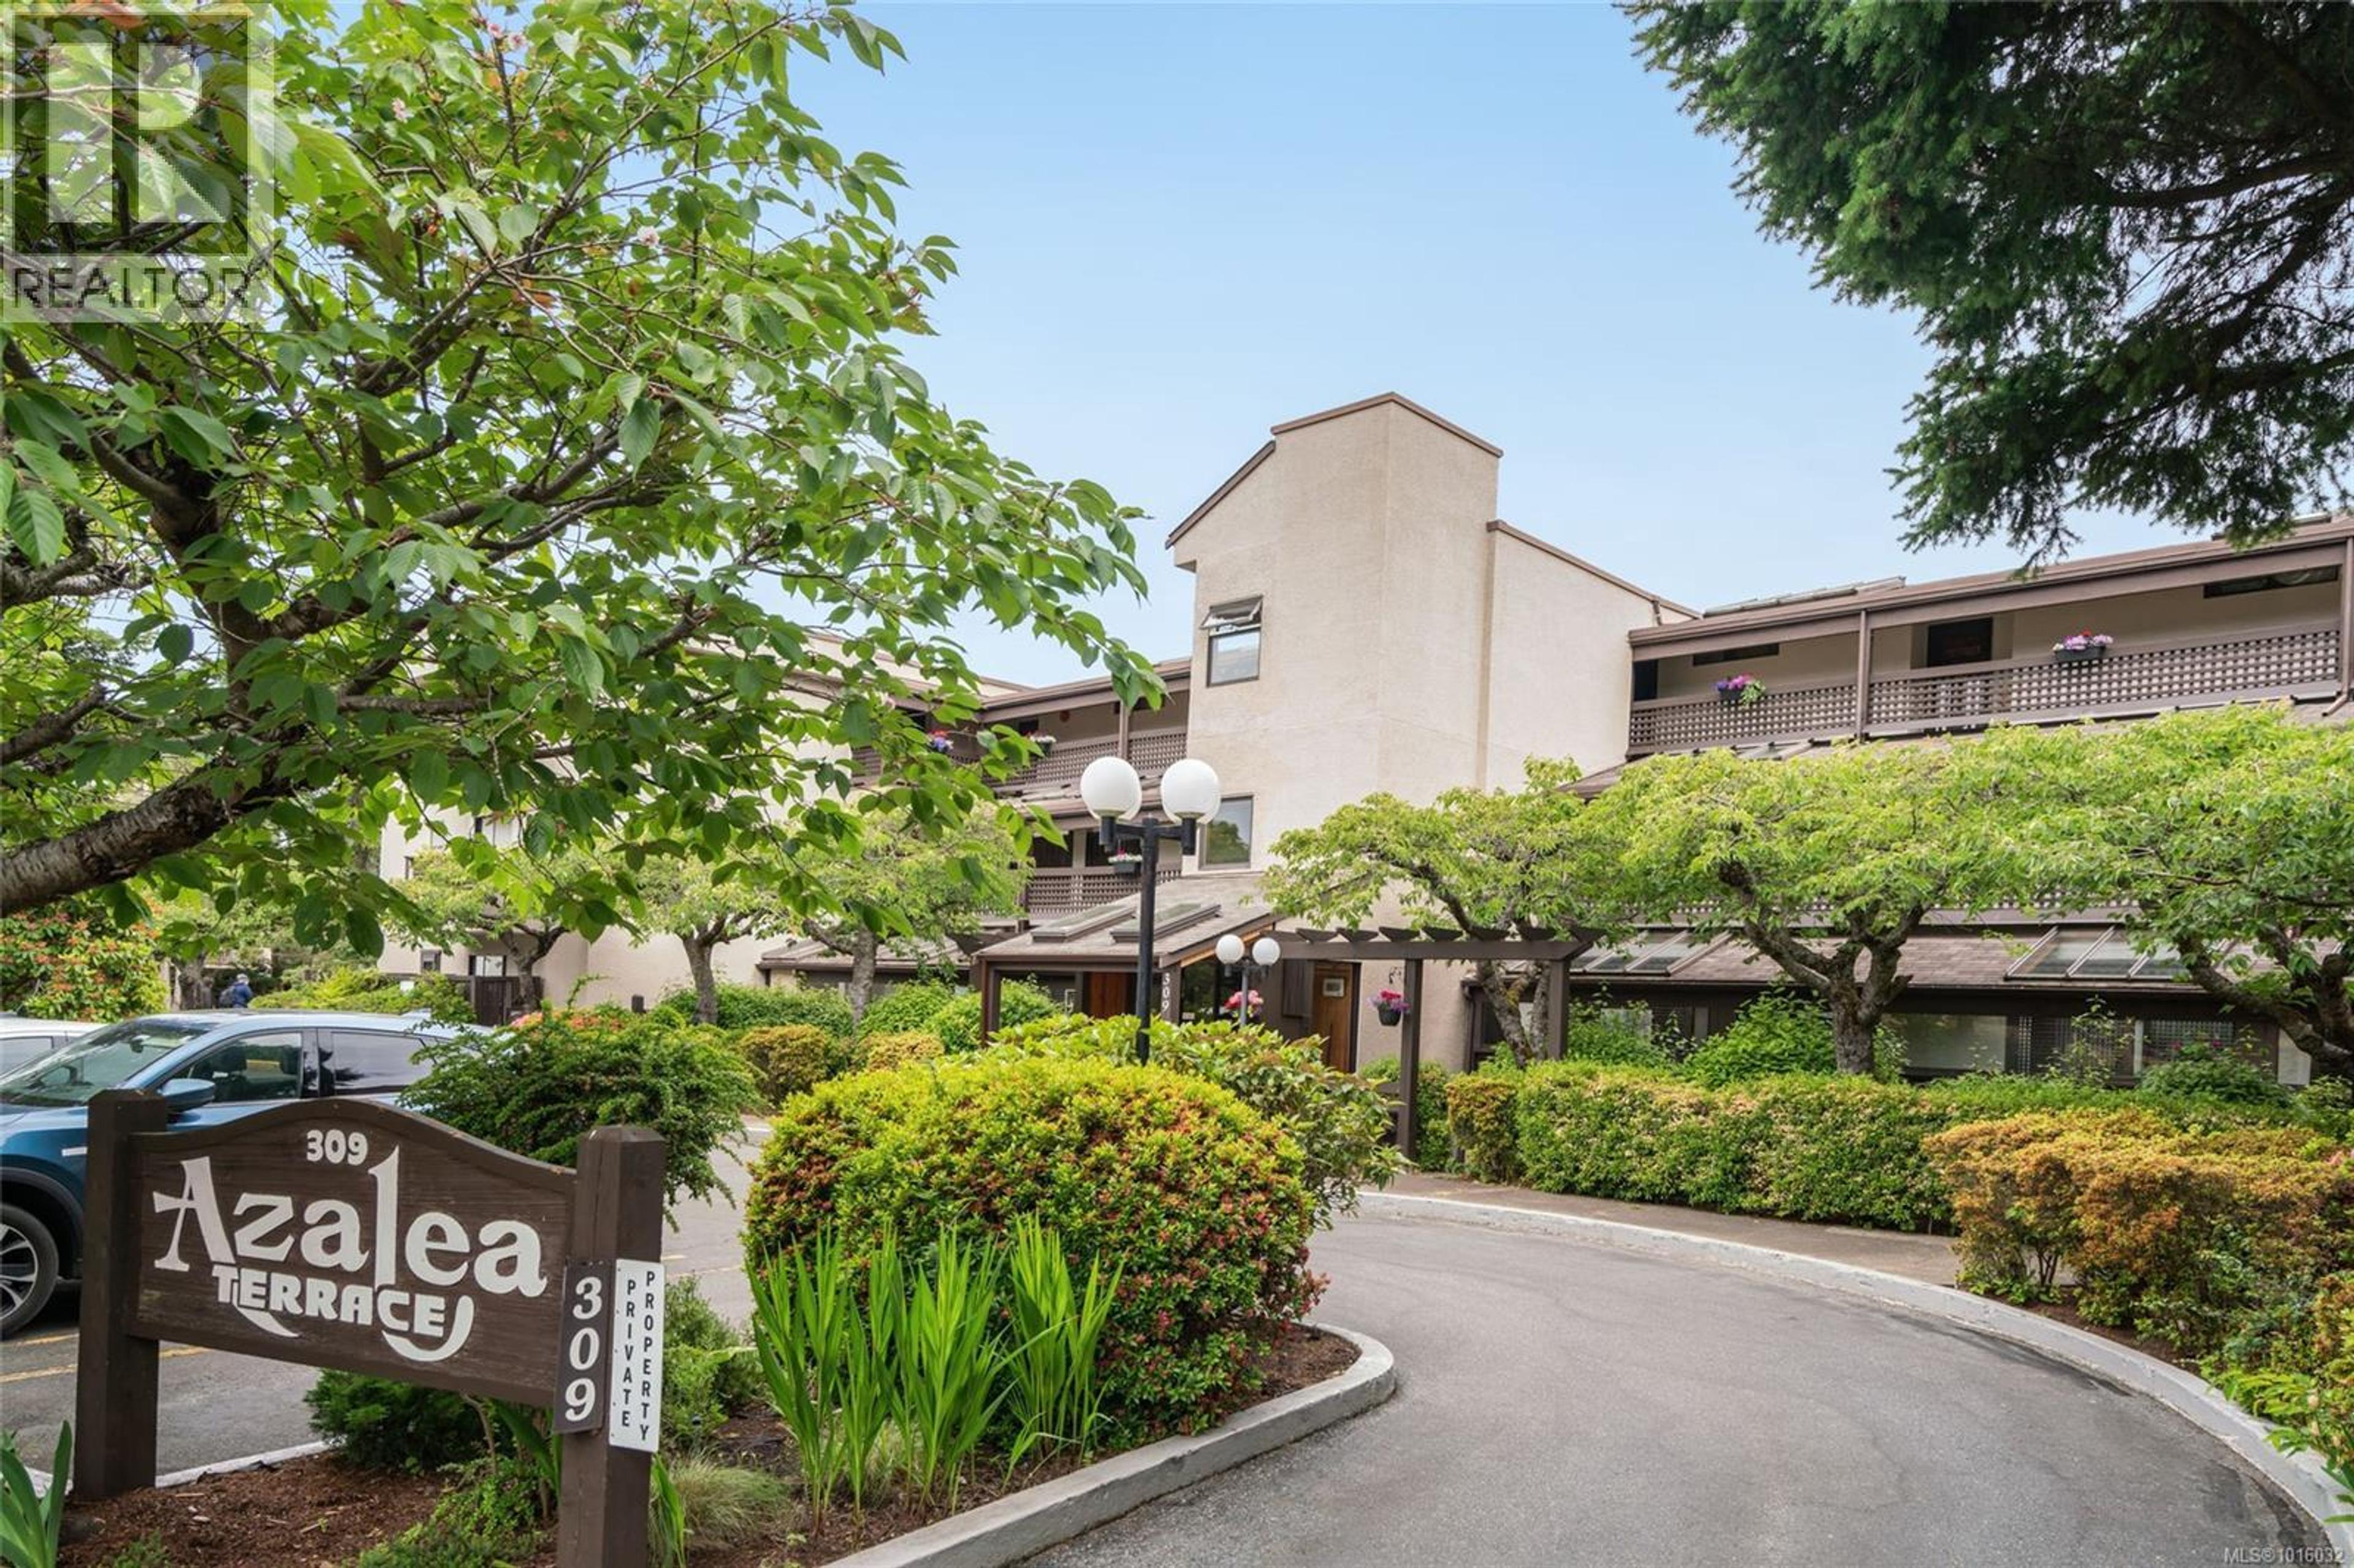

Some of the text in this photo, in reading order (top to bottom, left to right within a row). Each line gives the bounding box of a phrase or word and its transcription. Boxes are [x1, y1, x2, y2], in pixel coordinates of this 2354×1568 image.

[307, 1129, 368, 1165] 309
[153, 1144, 547, 1298] Azalea
[211, 1265, 448, 1339] TERRACE
[565, 1276, 603, 1422] 309
[622, 1279, 636, 1427] PRIVATE
[640, 1271, 655, 1441] PROPERTY
